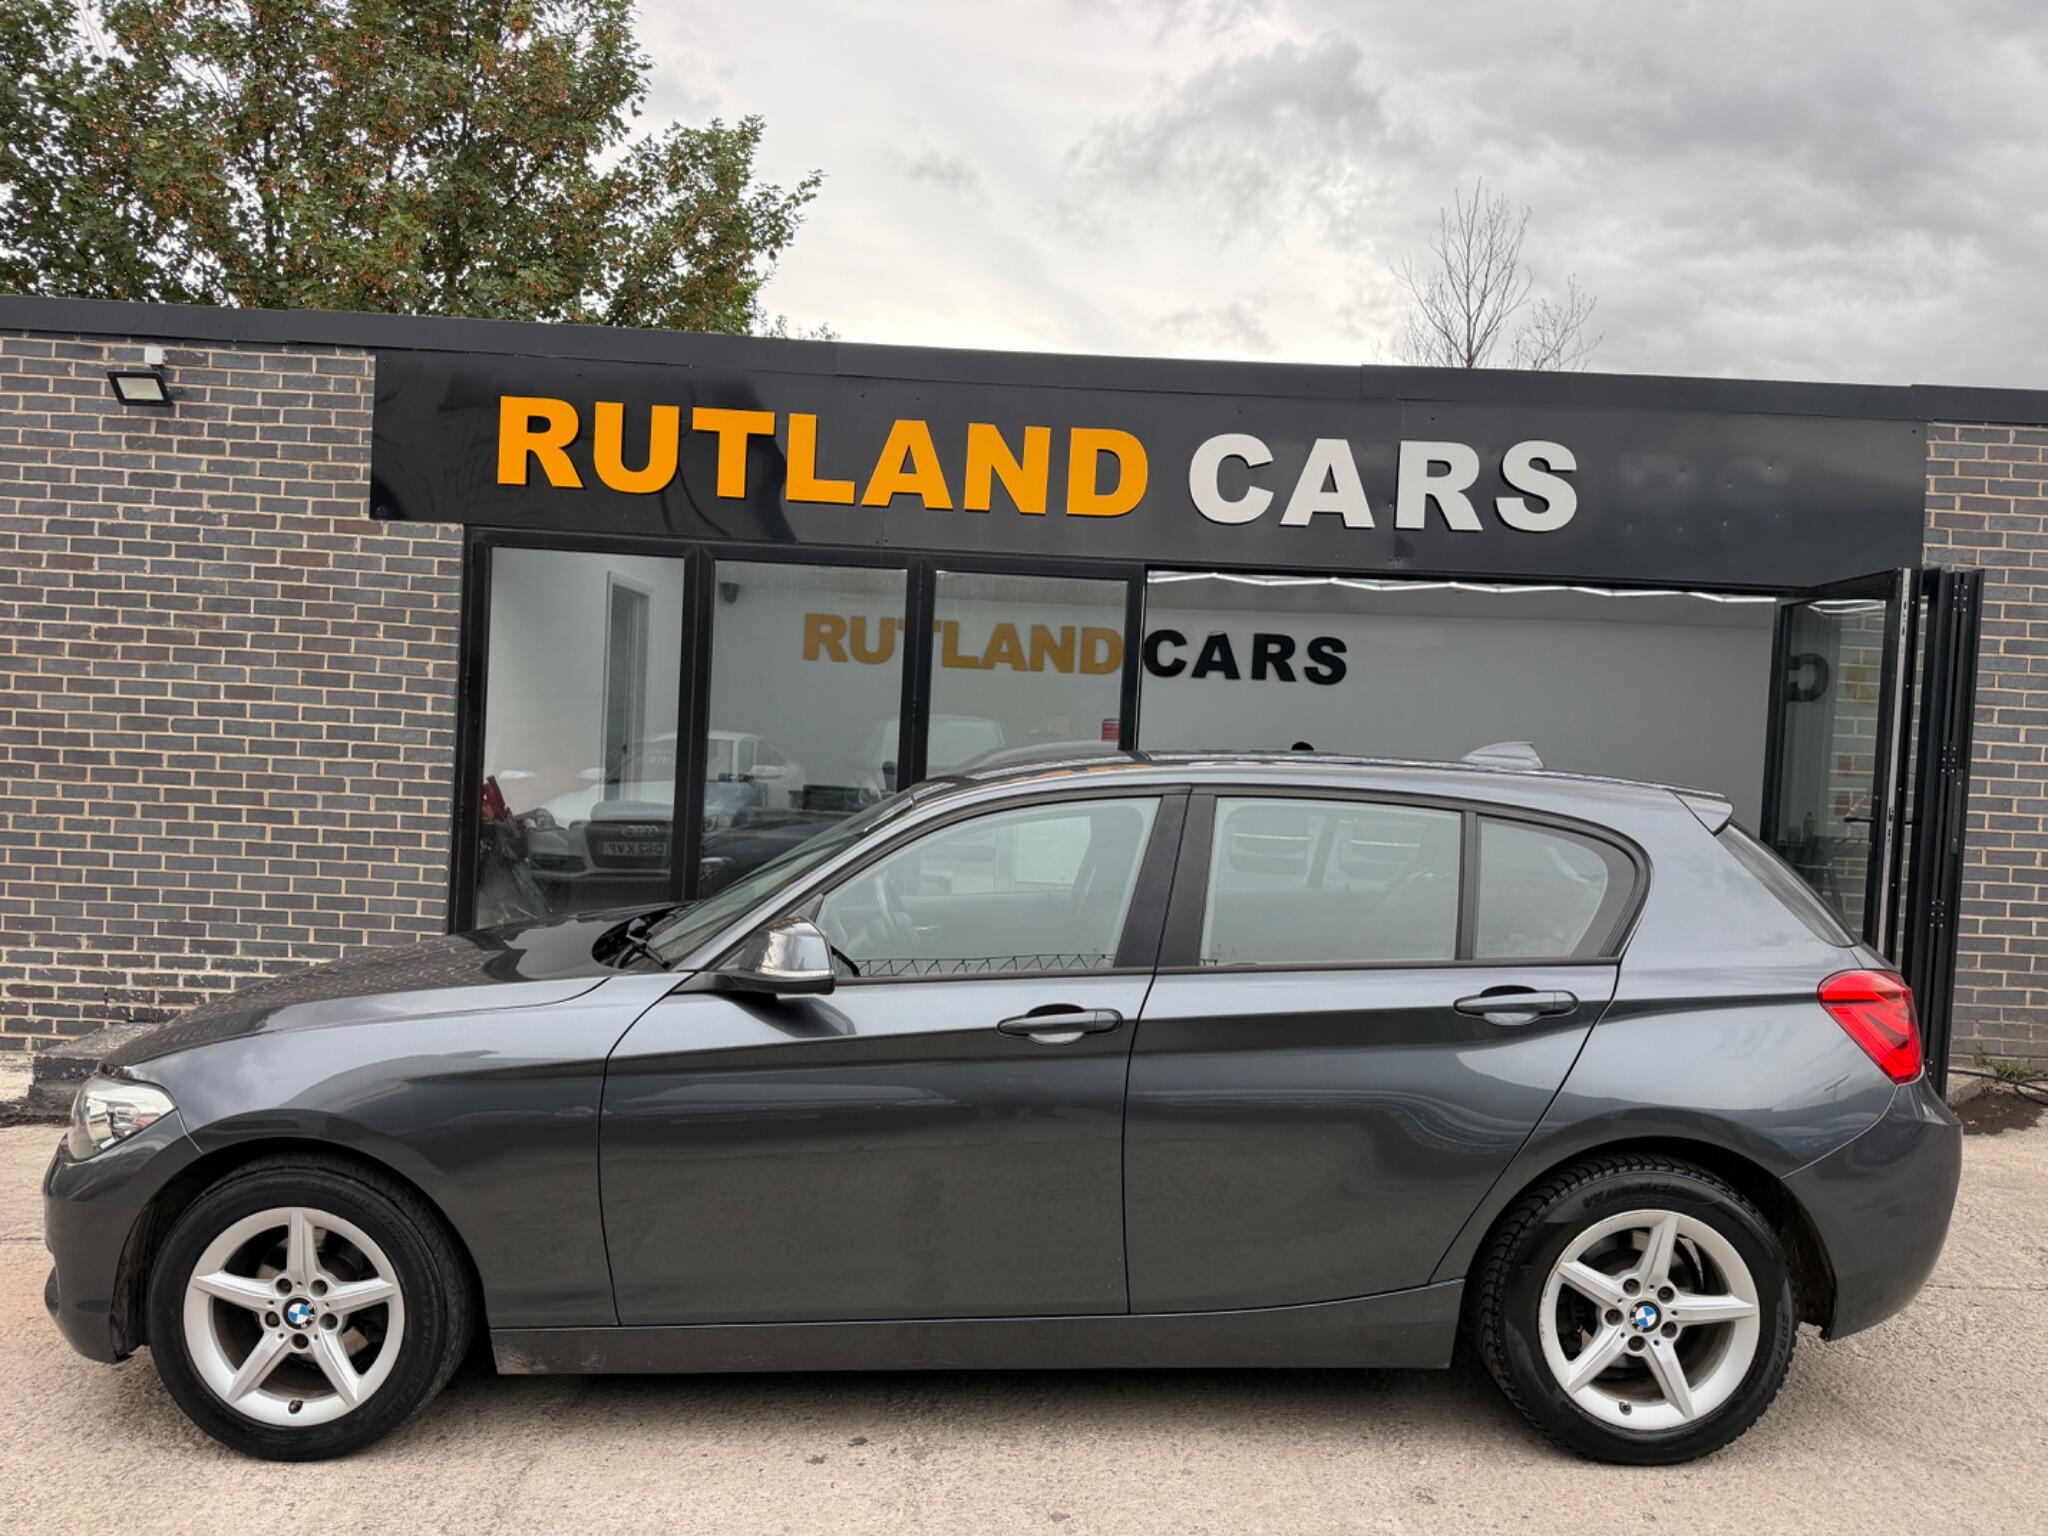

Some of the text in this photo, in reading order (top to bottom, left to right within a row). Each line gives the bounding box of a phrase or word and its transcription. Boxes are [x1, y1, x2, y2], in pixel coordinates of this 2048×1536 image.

[496, 395, 1579, 533] RUTLAND CARS
[803, 612, 1348, 686] RULAND CARS
